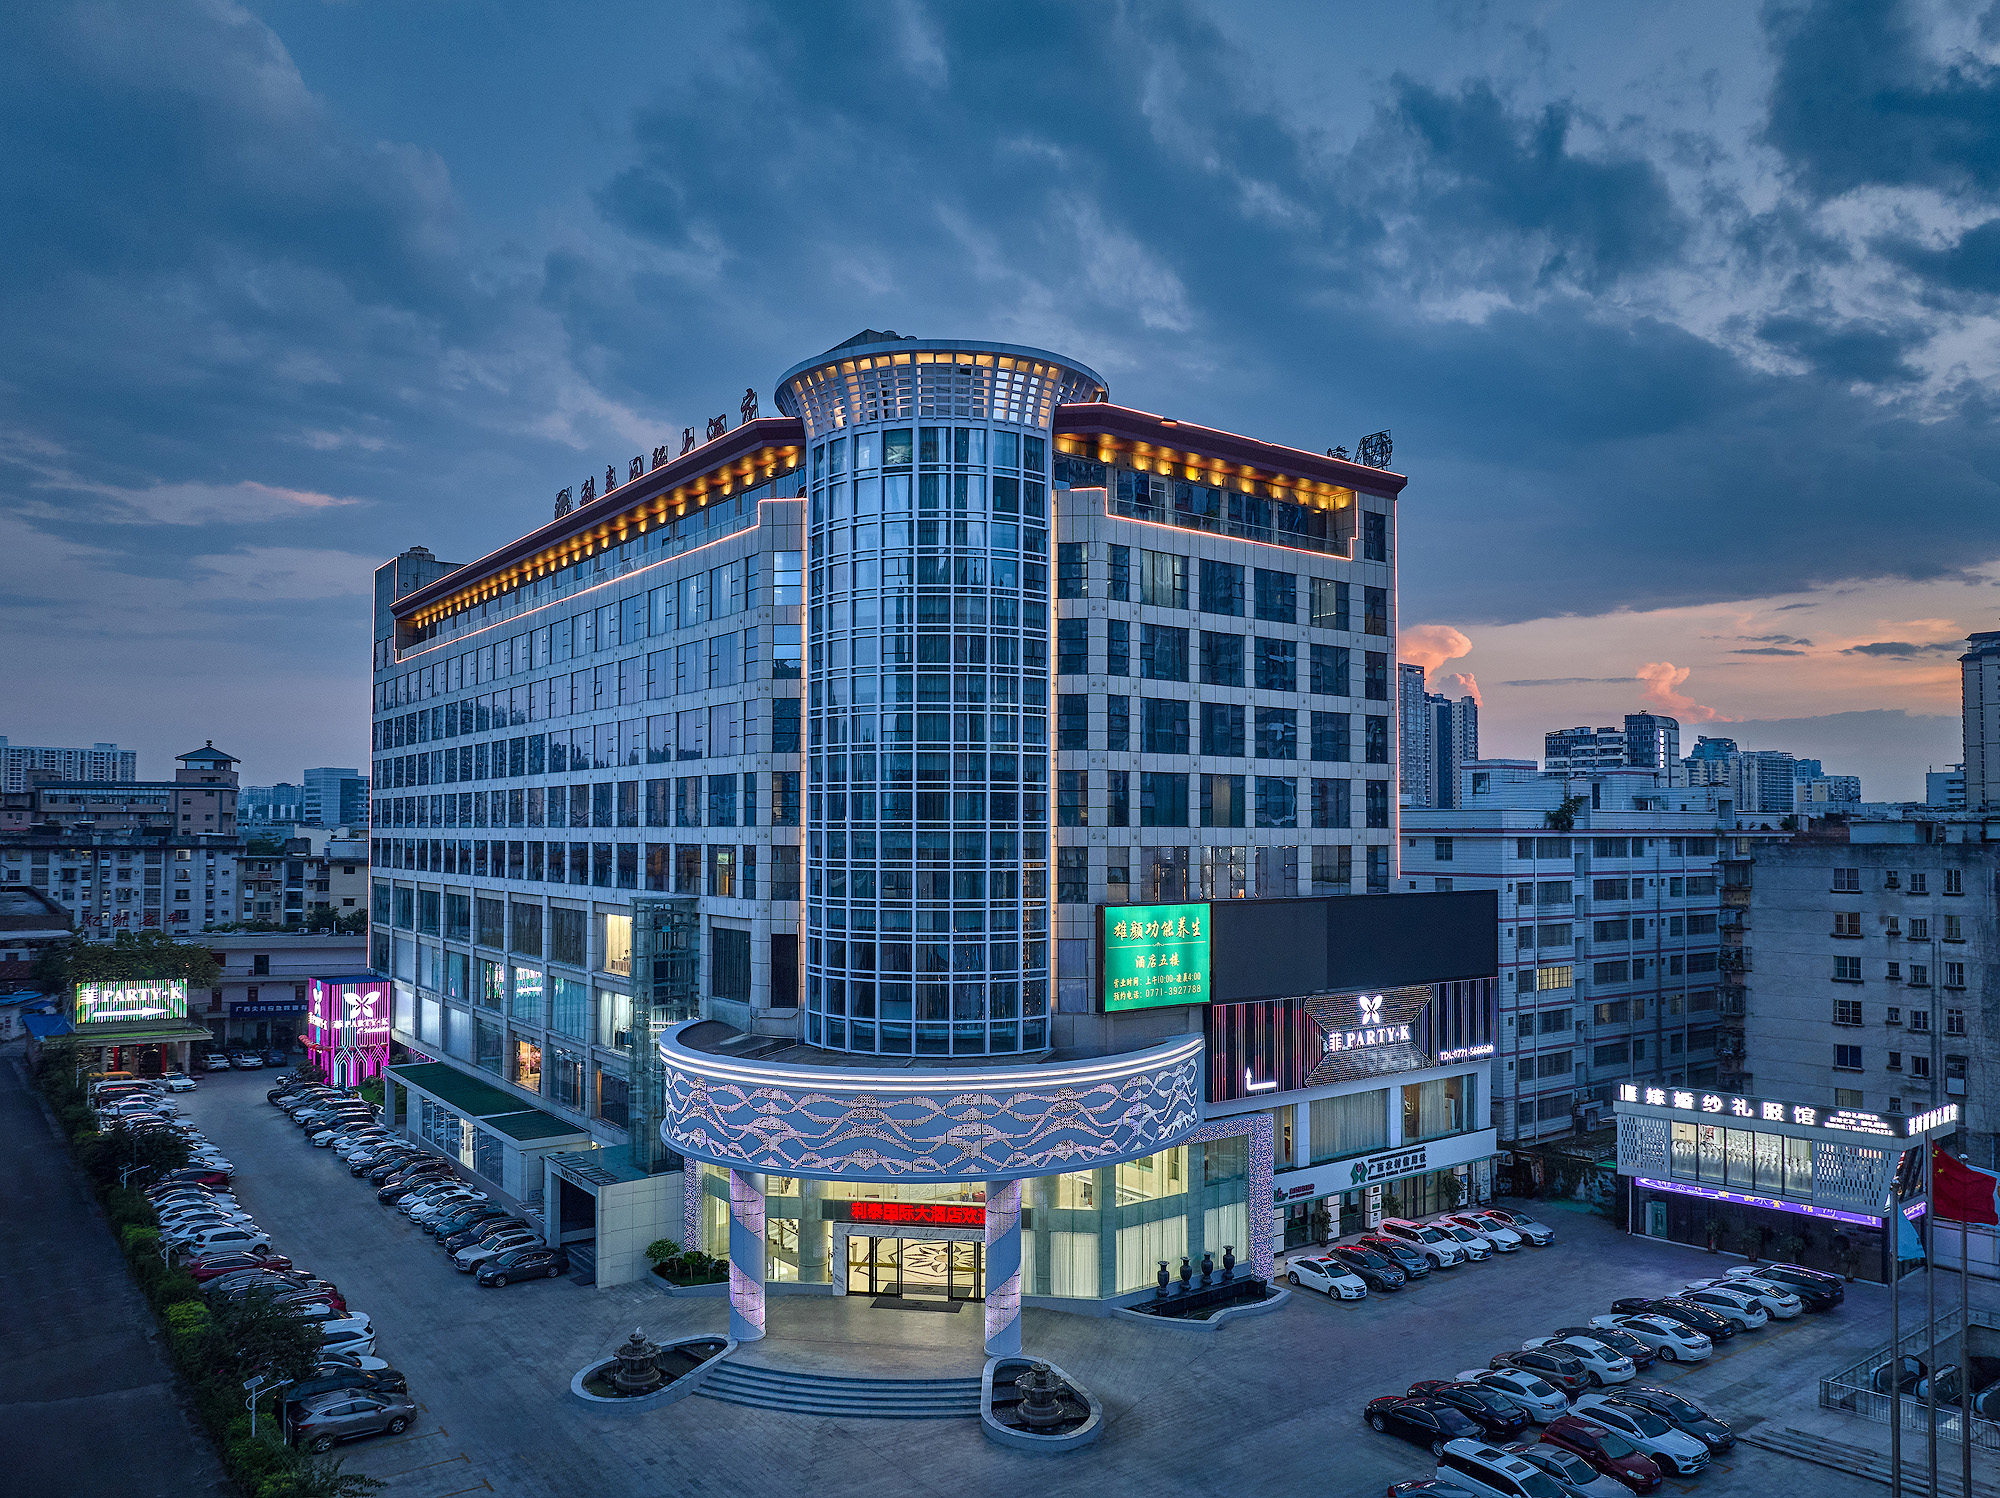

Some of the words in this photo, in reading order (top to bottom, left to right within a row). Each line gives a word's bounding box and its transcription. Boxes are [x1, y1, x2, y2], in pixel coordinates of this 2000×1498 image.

[1113, 916, 1201, 941] 雄颜功能养生
[1135, 952, 1180, 969] 酒店五楼
